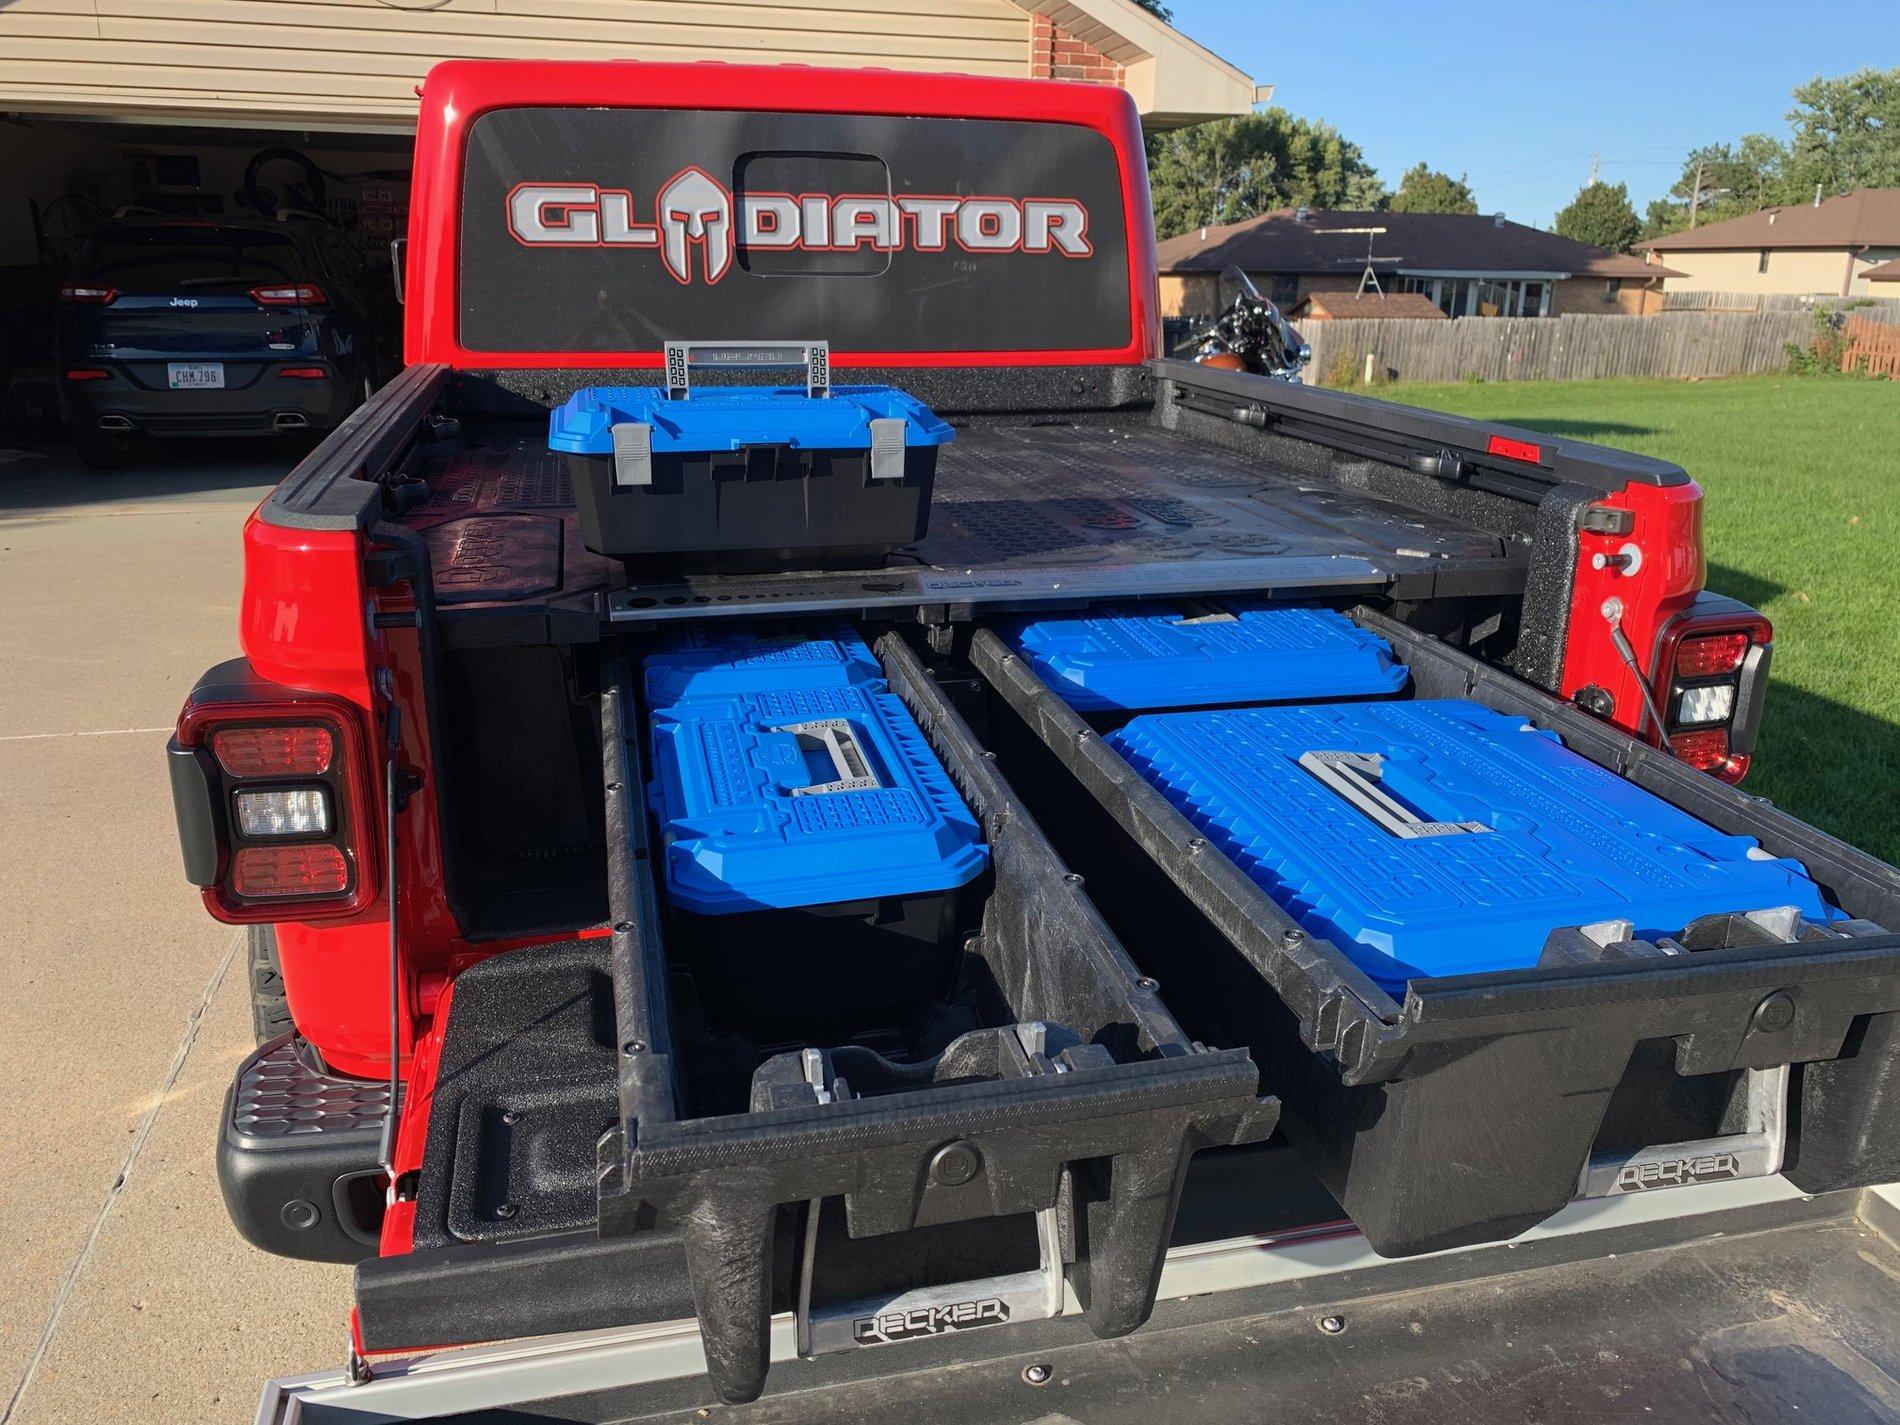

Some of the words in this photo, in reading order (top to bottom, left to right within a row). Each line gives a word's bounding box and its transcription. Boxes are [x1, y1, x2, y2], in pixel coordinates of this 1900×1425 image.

[169, 297, 199, 309] Jeep
[175, 370, 196, 383] CHM
[198, 370, 217, 383] 796
[1619, 1152, 1740, 1192] DECKED
[853, 1298, 1010, 1346] DECKED
